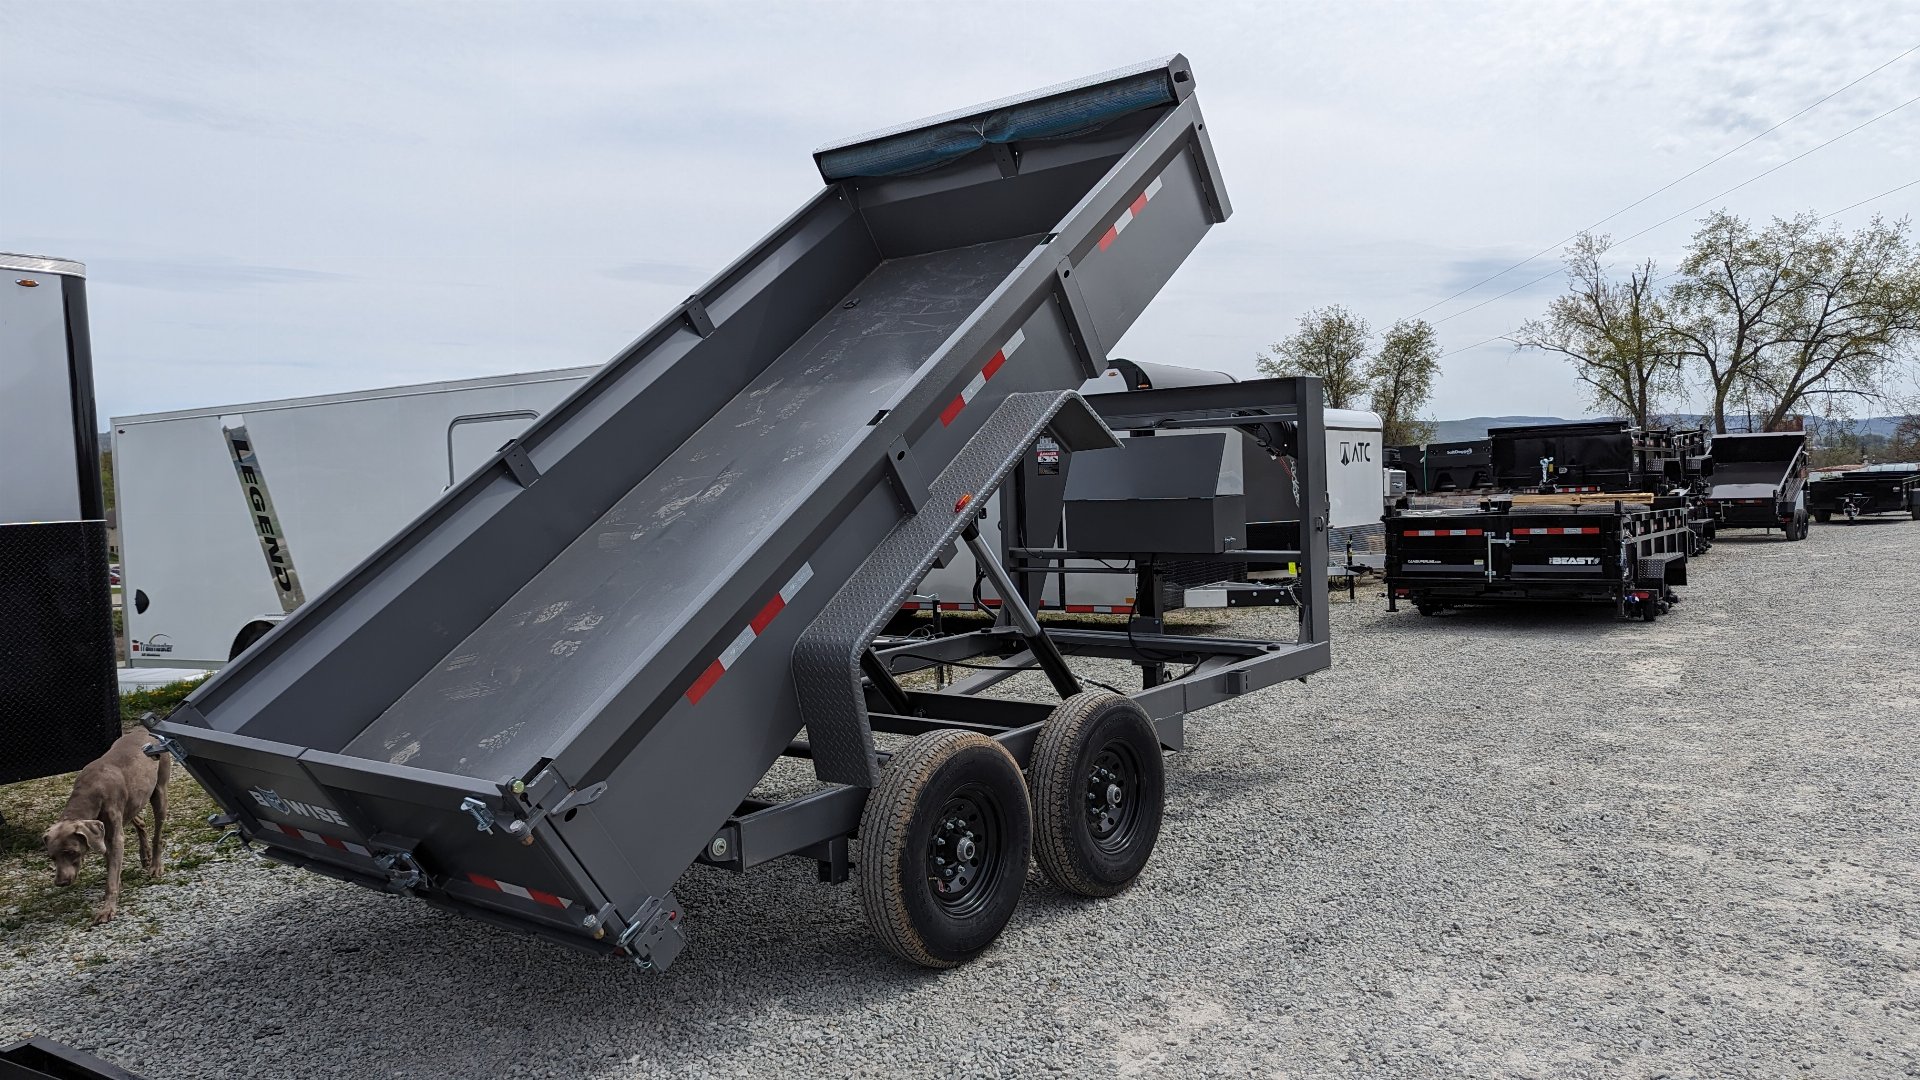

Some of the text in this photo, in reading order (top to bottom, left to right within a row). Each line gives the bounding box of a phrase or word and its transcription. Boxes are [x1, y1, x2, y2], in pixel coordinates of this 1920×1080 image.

[1351, 442, 1371, 463] ATC
[231, 439, 293, 592] LEGEND
[1552, 556, 1595, 565] BEAST
